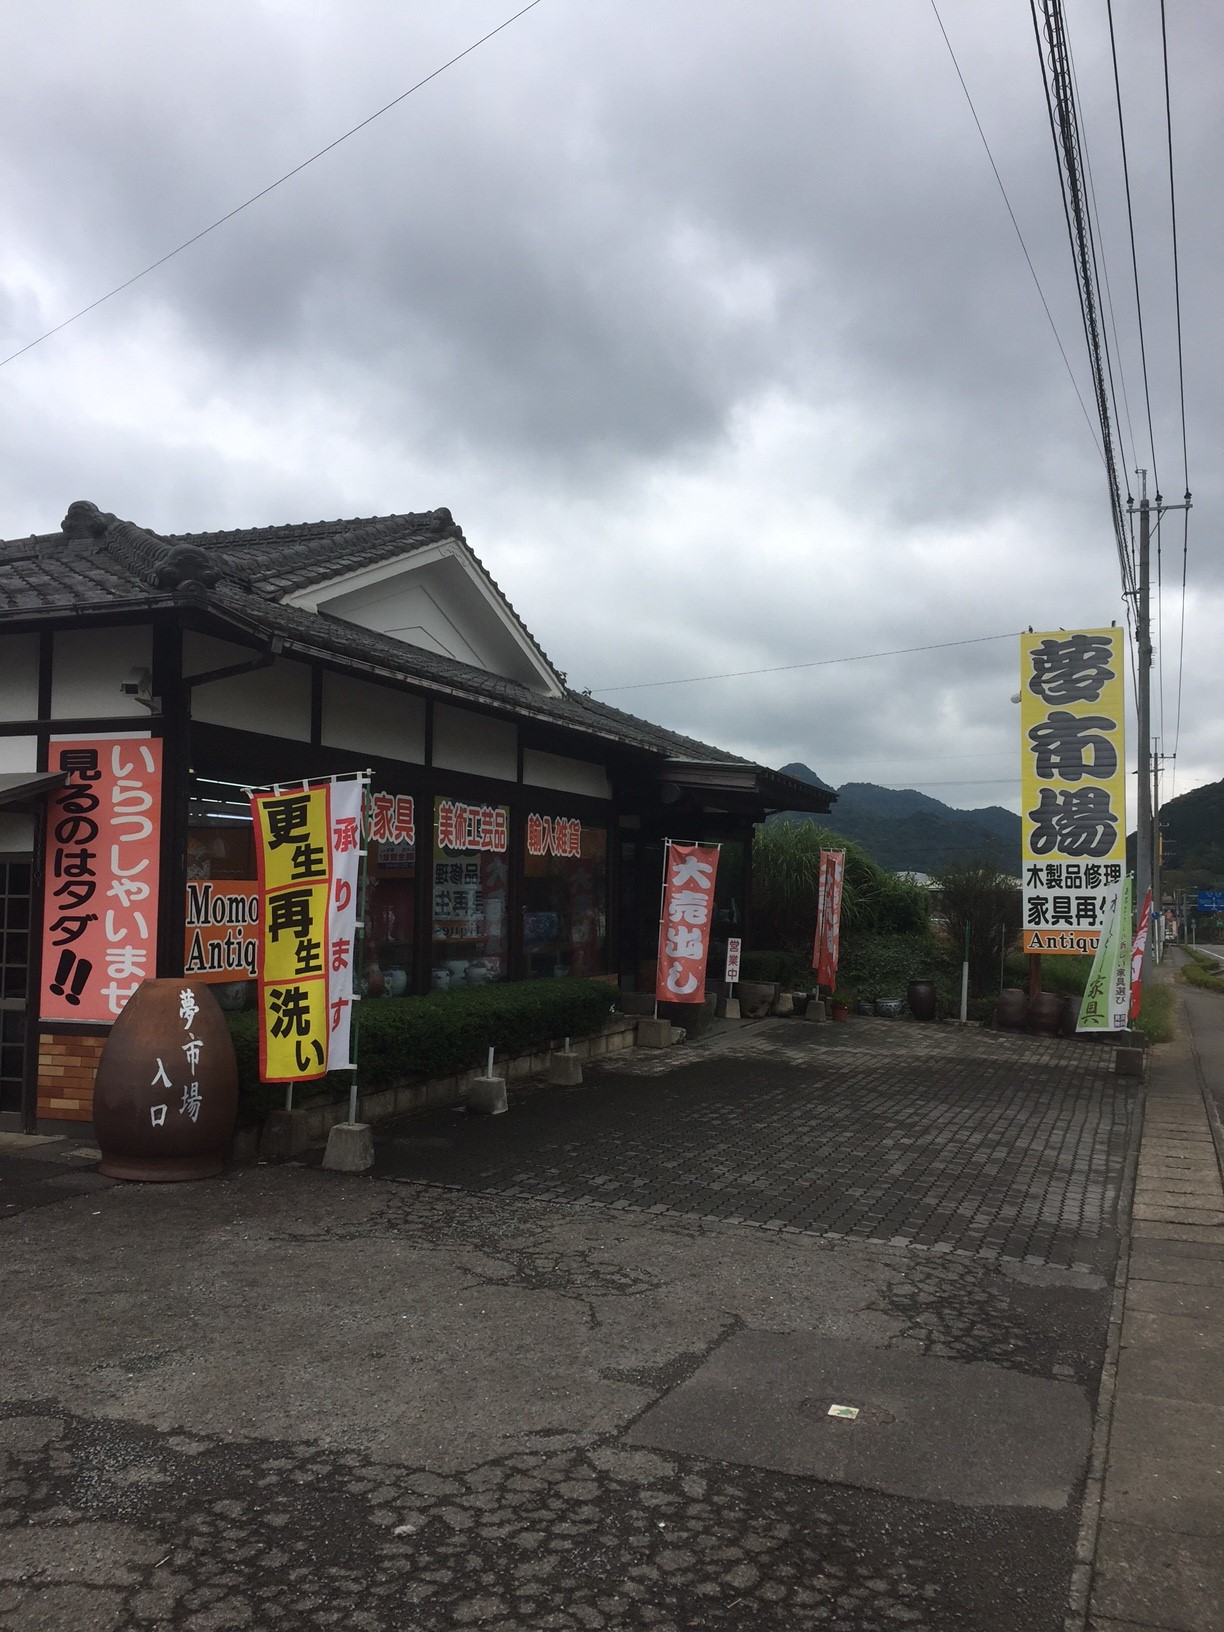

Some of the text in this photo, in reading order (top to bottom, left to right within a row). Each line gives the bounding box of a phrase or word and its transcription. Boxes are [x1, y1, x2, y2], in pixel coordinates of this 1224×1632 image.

[1028, 634, 1118, 858] 夢市場
[438, 800, 508, 853] 美術工芸品
[527, 812, 582, 857] 輸入雑貨
[186, 884, 259, 926] Momo
[1026, 863, 1121, 891] 木製品修理
[185, 926, 258, 975] Antiq
[262, 794, 326, 1072] 更生 再生 洗い
[331, 816, 359, 1033] 承ります
[666, 855, 713, 995] 大売出し
[728, 939, 740, 980] 営業中
[179, 988, 203, 1124] 夢市場
[150, 1057, 172, 1127] 入口
